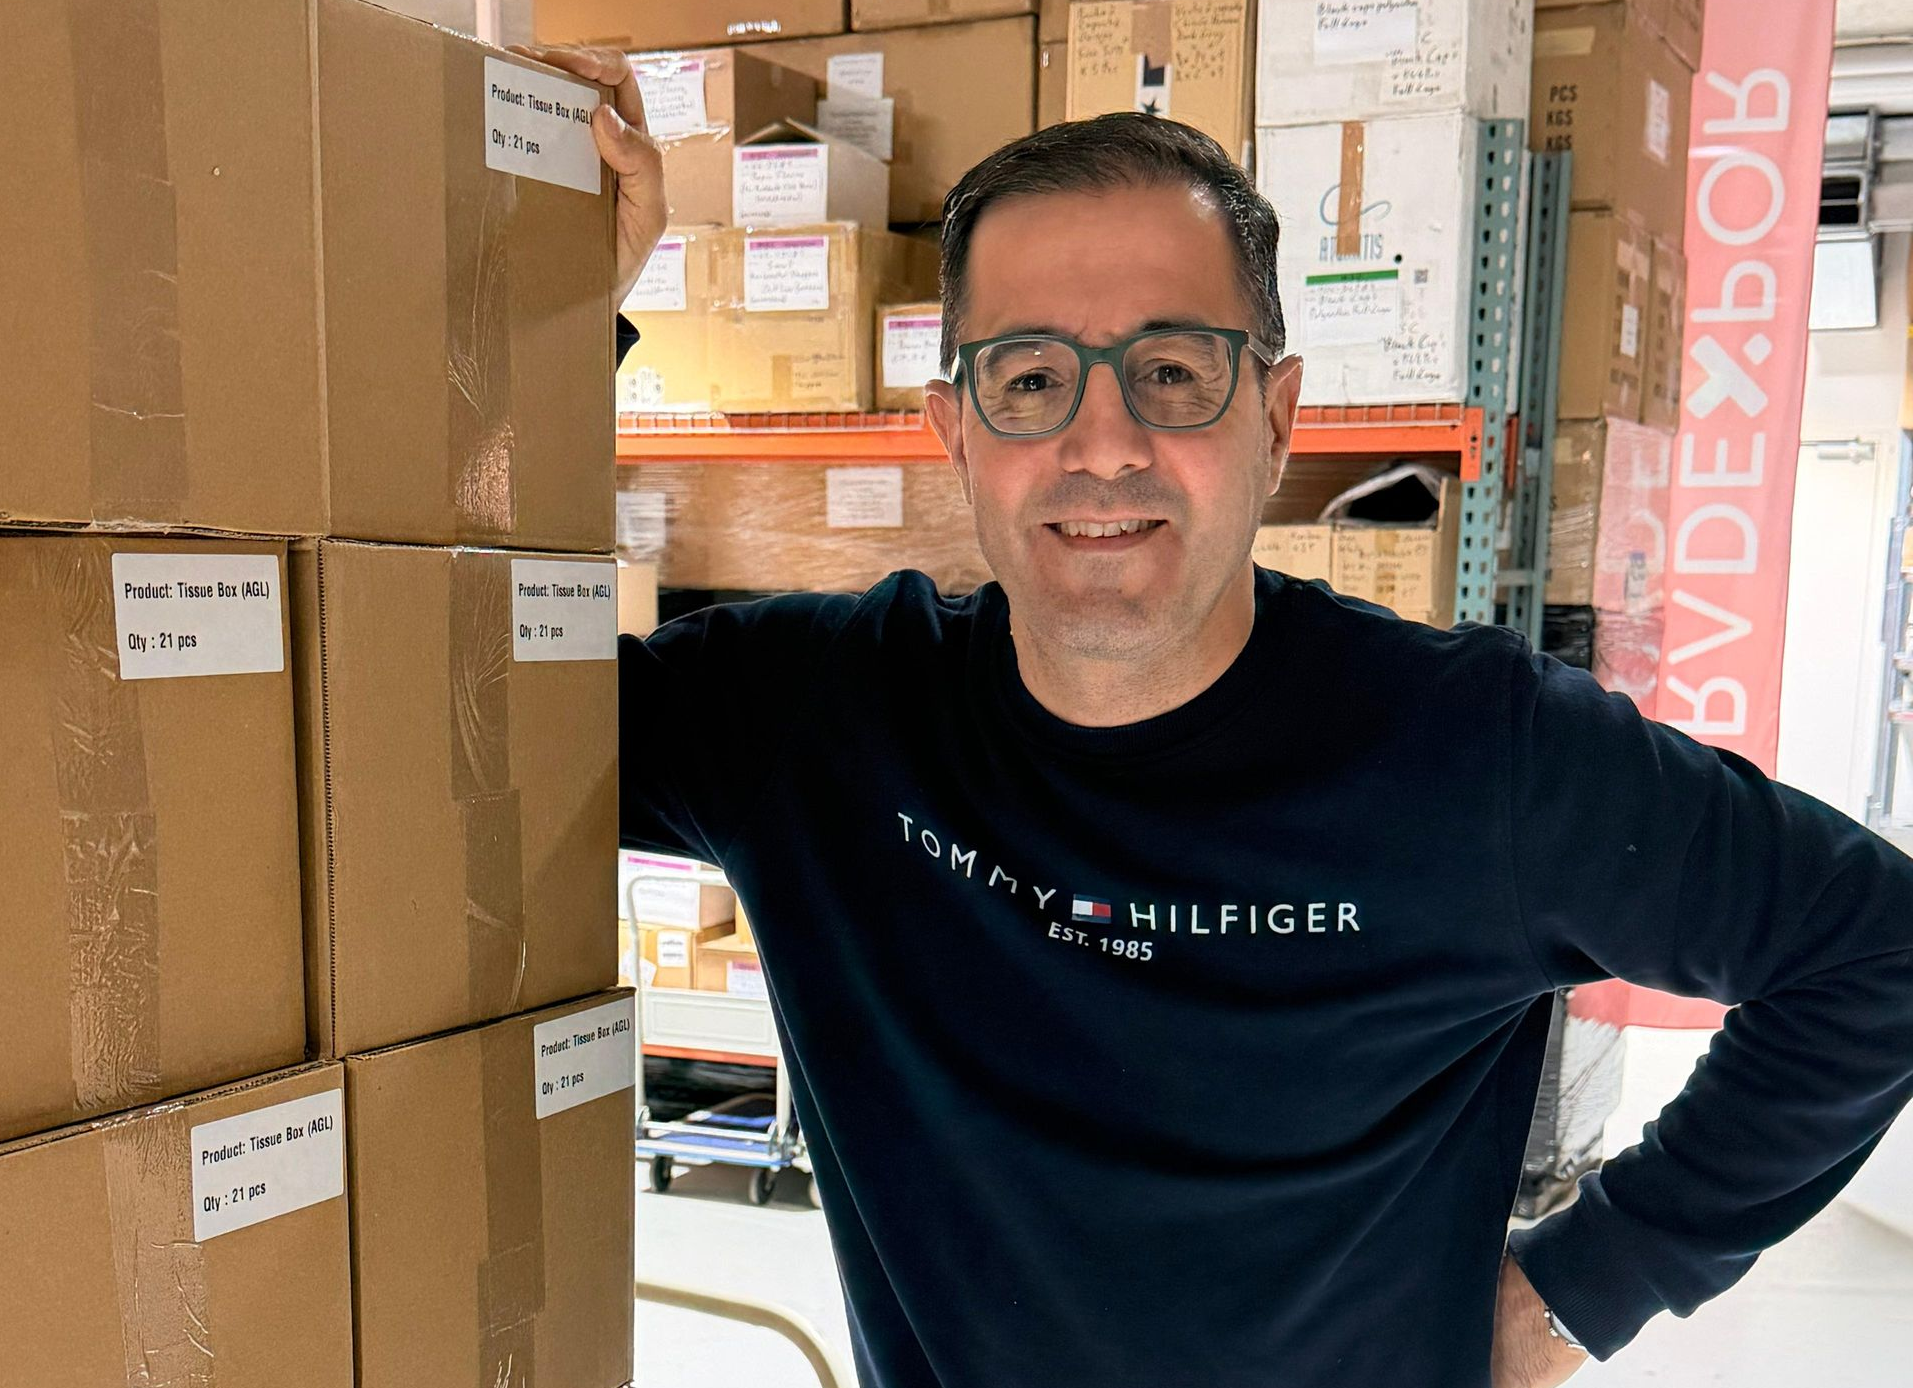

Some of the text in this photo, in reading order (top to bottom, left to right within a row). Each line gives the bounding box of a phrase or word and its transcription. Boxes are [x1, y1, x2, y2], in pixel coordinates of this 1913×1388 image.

[491, 84, 525, 106] Product:
[528, 94, 553, 114] Tissue
[555, 102, 570, 119] Box
[1549, 84, 1579, 103] PCS
[1546, 109, 1574, 127] KGS
[492, 128, 506, 148] Qty
[513, 134, 523, 150] 21
[526, 140, 540, 154] pcs
[124, 581, 270, 600] Product: Tissue Box (AGL)
[519, 583, 611, 600] Product: Tissue Box (AGL)
[128, 633, 147, 653] Qty
[160, 632, 173, 648] 21
[178, 634, 197, 651] pcs
[520, 624, 531, 640] Qty
[539, 624, 548, 637] 21
[551, 626, 563, 640] pcs
[897, 811, 1361, 935] TOMMY HILFIGER
[1048, 921, 1153, 962] EST. 1985
[541, 1018, 630, 1058] Product: Tissue Box (AGL)
[542, 1082, 553, 1095] Qty
[561, 1074, 569, 1088] 21
[572, 1072, 584, 1087] pcs
[202, 1115, 333, 1166] Product: Tissue Box (AGL)
[203, 1196, 221, 1213] Qty
[232, 1187, 244, 1203] 21
[249, 1182, 266, 1201] pcs
